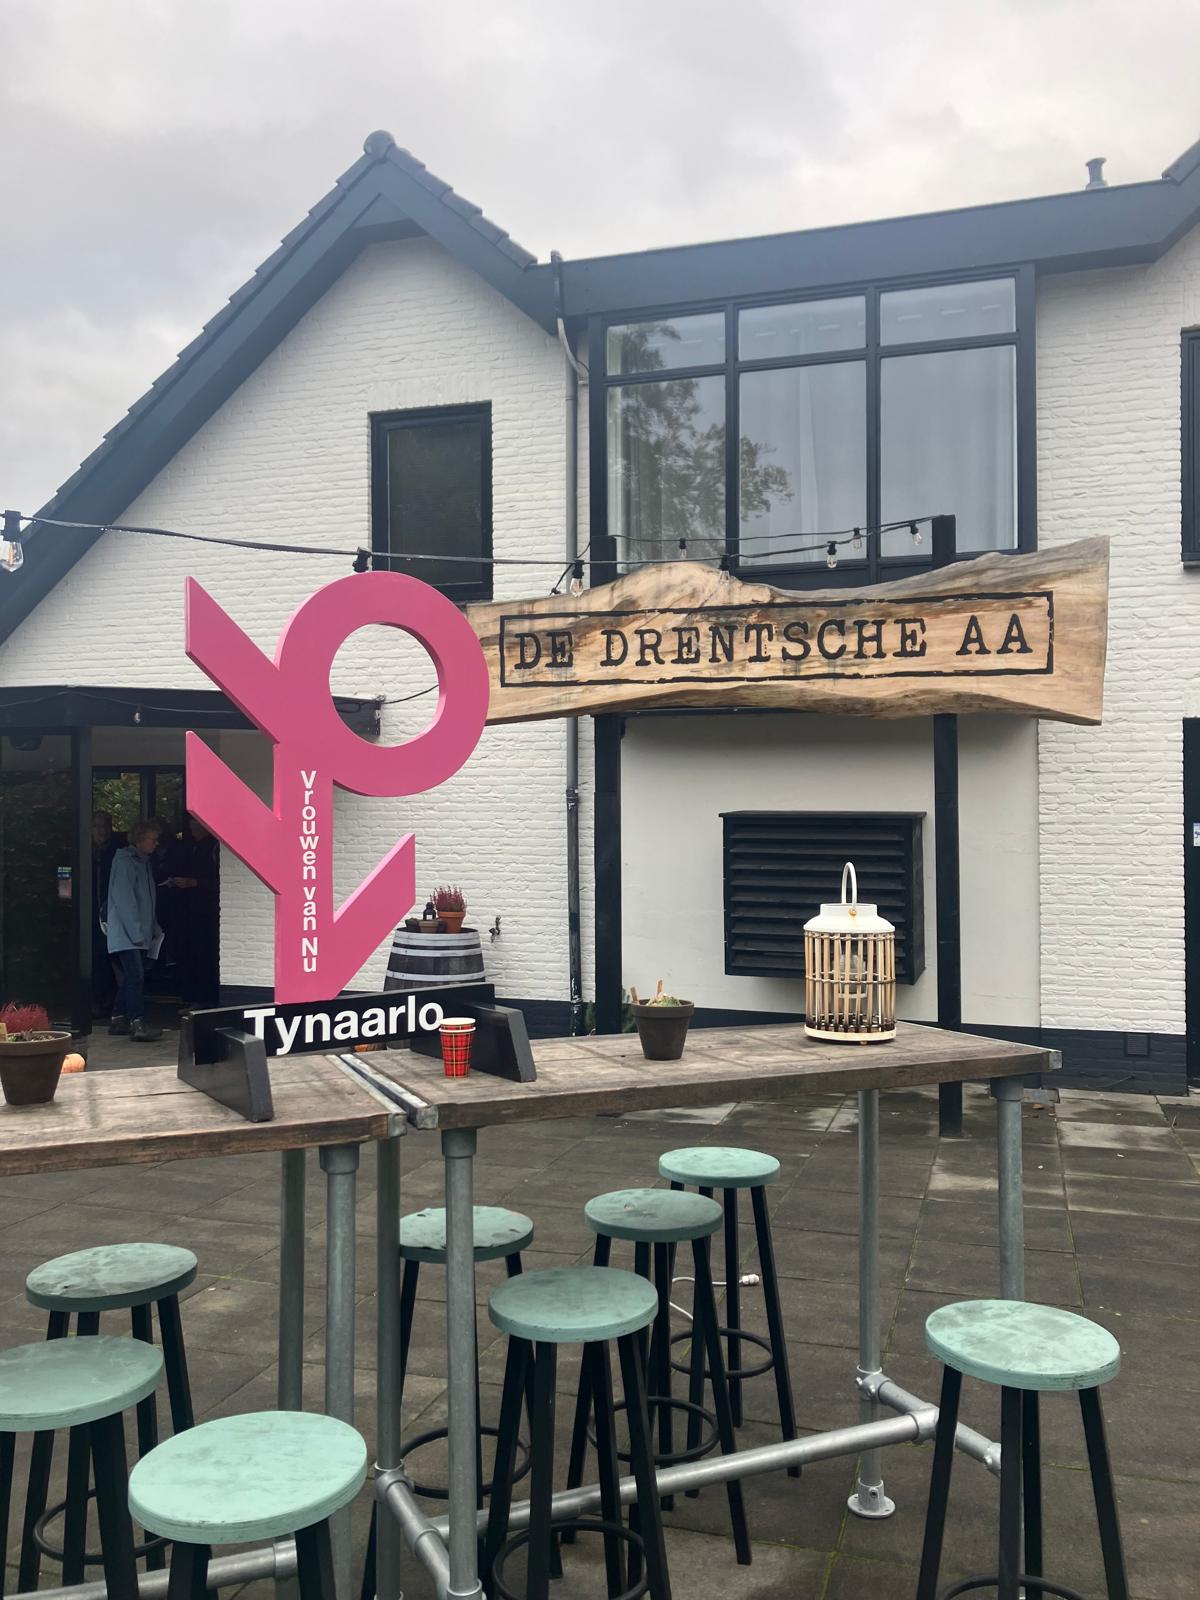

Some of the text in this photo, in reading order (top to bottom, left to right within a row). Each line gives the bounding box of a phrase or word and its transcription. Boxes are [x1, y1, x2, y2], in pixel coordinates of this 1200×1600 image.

[514, 613, 1034, 670] DE DRENTSCHE AA
[299, 770, 319, 973] Vrouwen van Nu
[243, 995, 444, 1056] Tynaarlo
